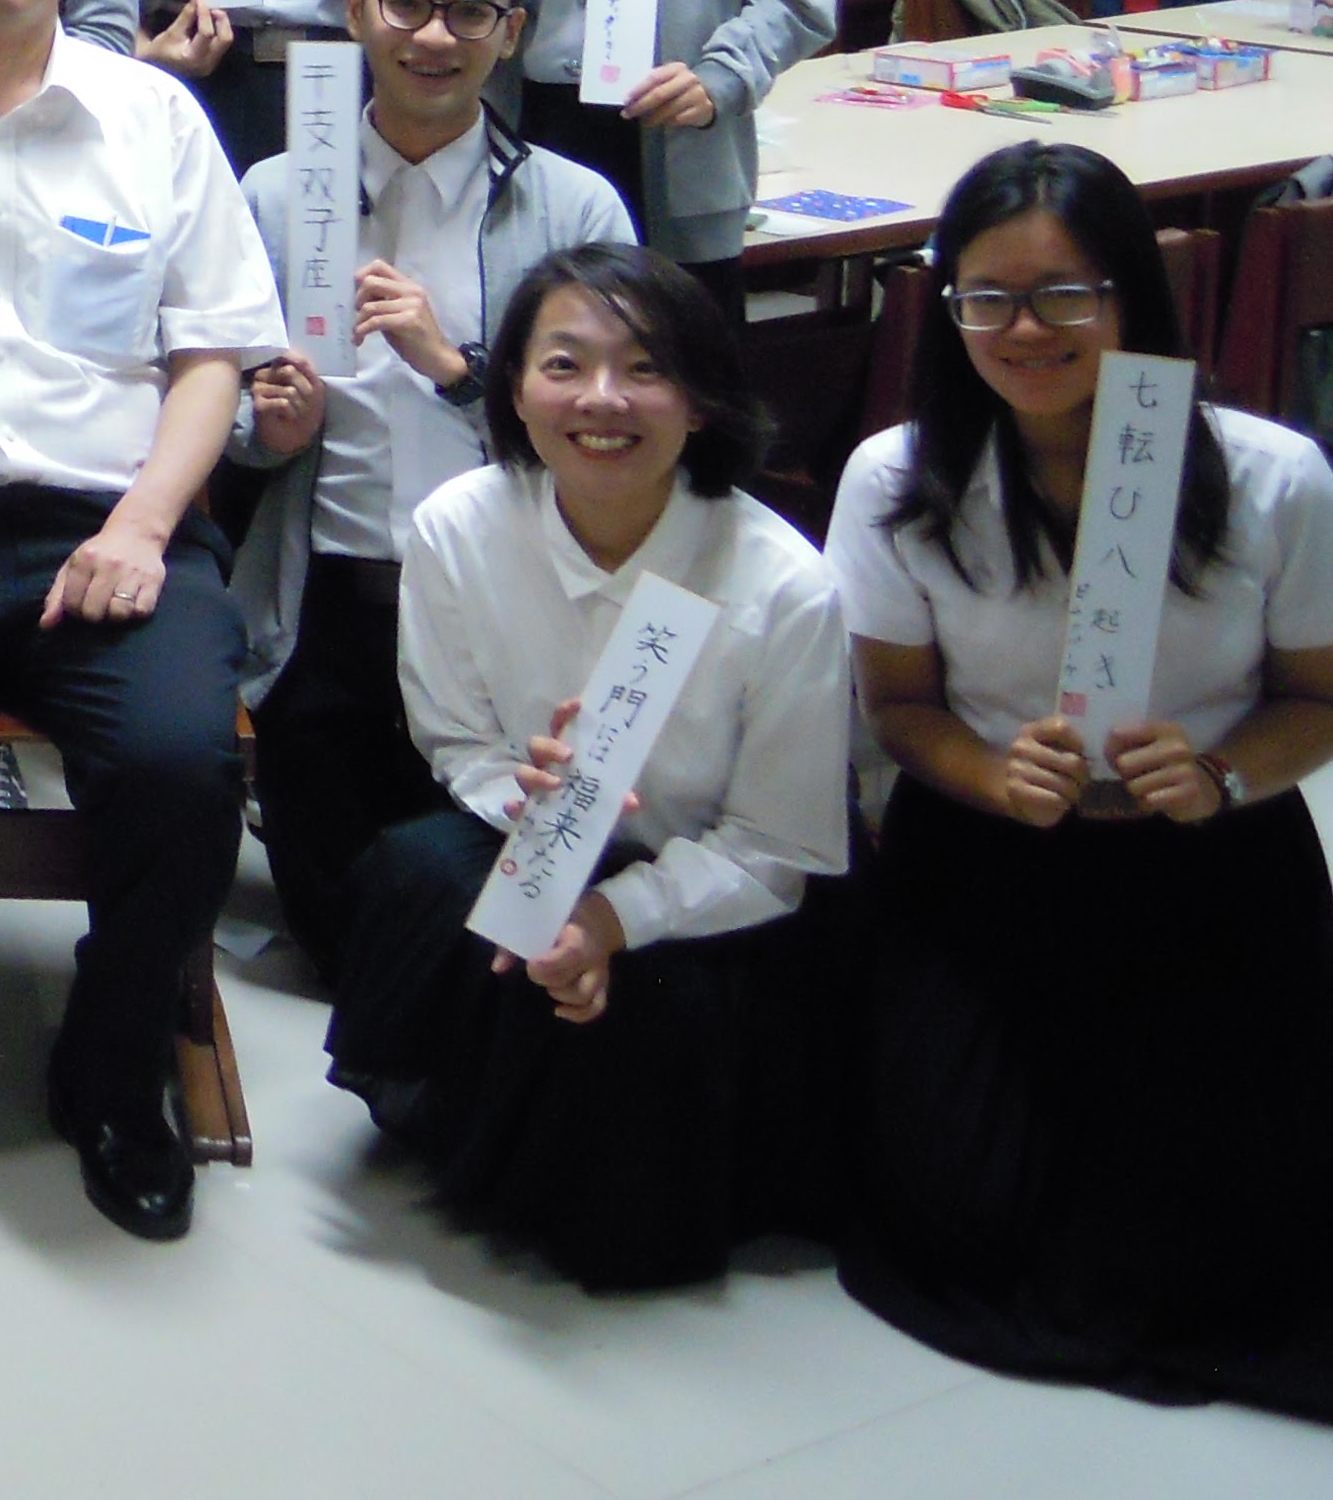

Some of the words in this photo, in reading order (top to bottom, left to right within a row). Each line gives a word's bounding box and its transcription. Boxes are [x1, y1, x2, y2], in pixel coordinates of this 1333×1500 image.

[1091, 370, 1160, 689] 七転び八起き
